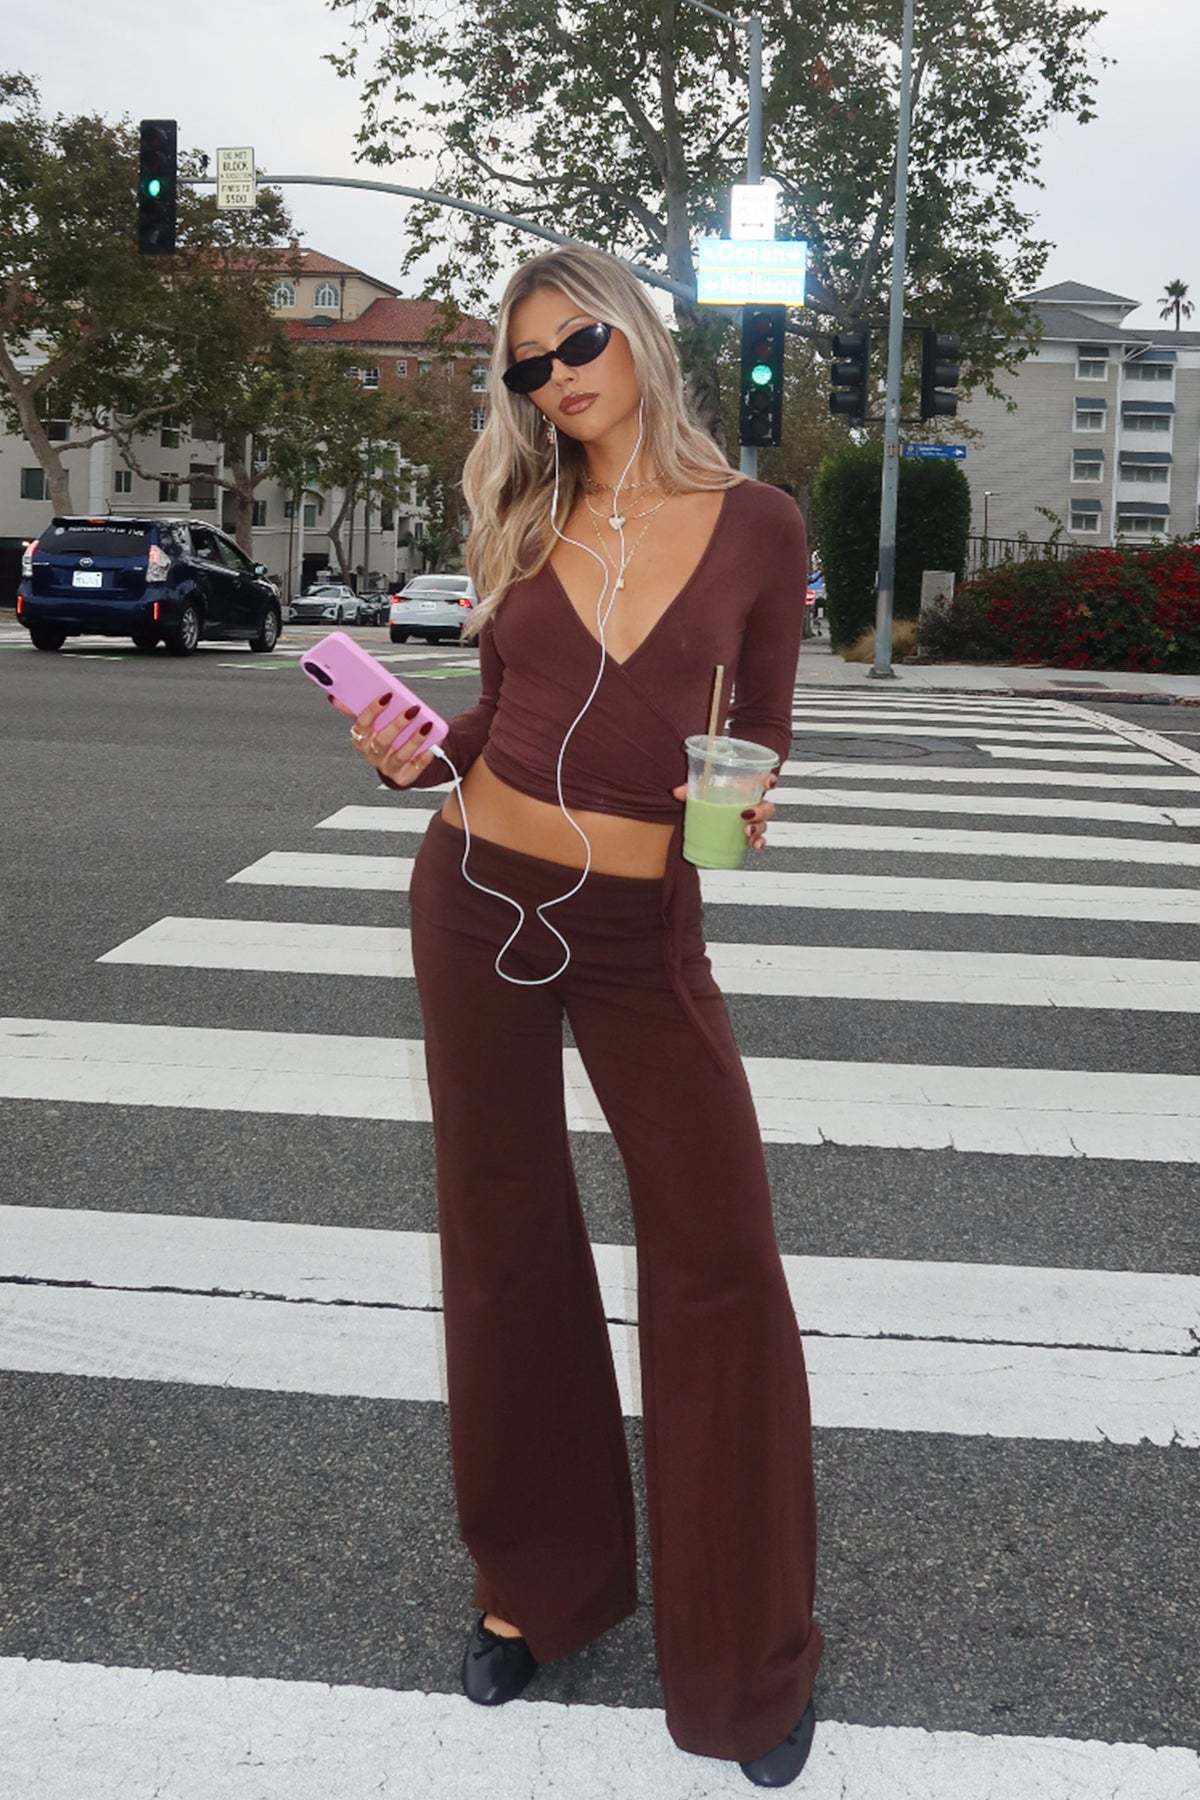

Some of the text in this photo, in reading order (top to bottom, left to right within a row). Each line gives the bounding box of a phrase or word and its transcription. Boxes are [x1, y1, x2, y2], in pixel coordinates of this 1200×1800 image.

[223, 161, 249, 171] BLOCK
[226, 194, 247, 204] $500
[719, 243, 785, 264] Ocean
